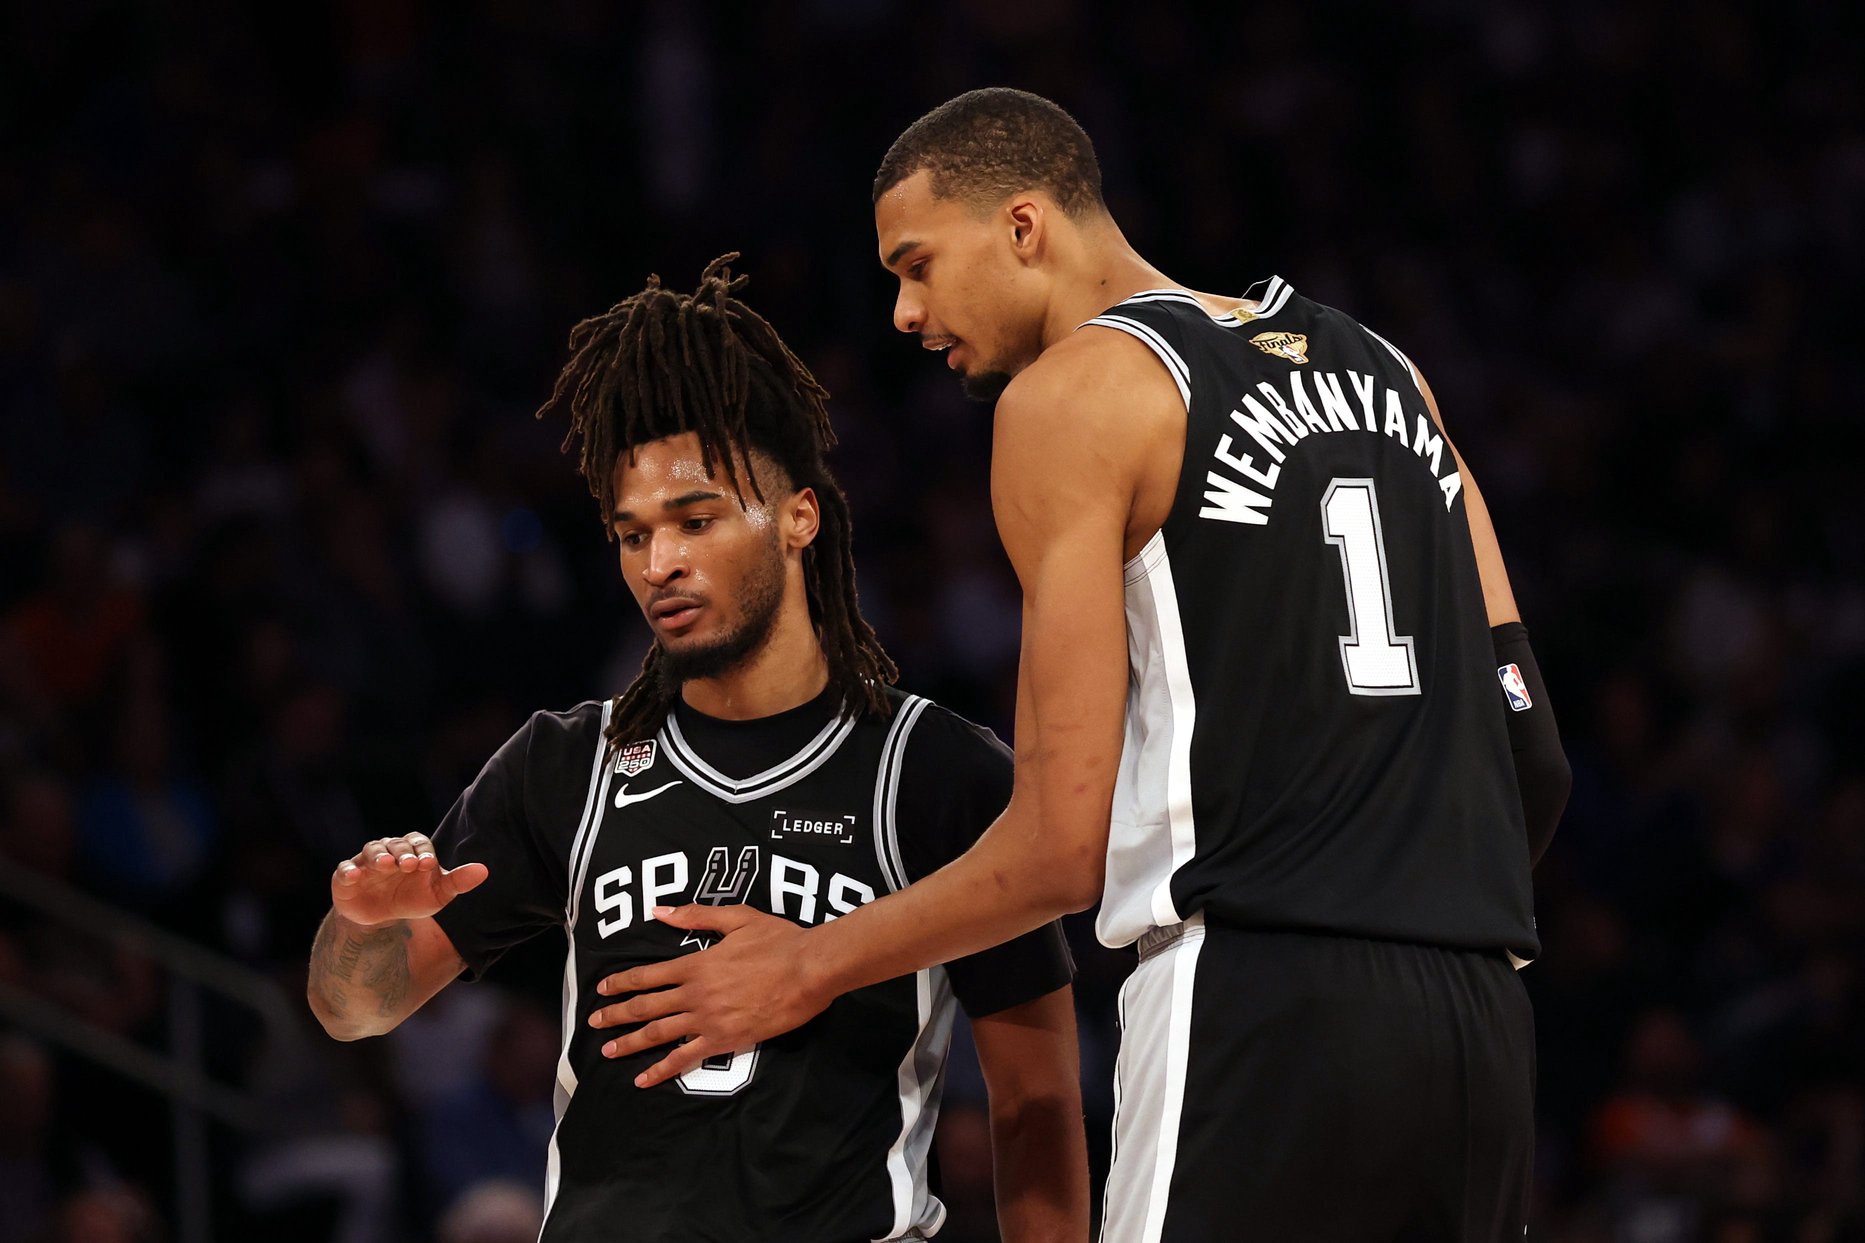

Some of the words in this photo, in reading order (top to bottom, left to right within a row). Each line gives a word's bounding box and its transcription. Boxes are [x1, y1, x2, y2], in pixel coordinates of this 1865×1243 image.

[1199, 369, 1461, 525] WEMBANYAMA
[1320, 477, 1422, 697] 1
[623, 744, 651, 756] USA
[618, 758, 651, 770] 250
[782, 818, 844, 835] LEDGER
